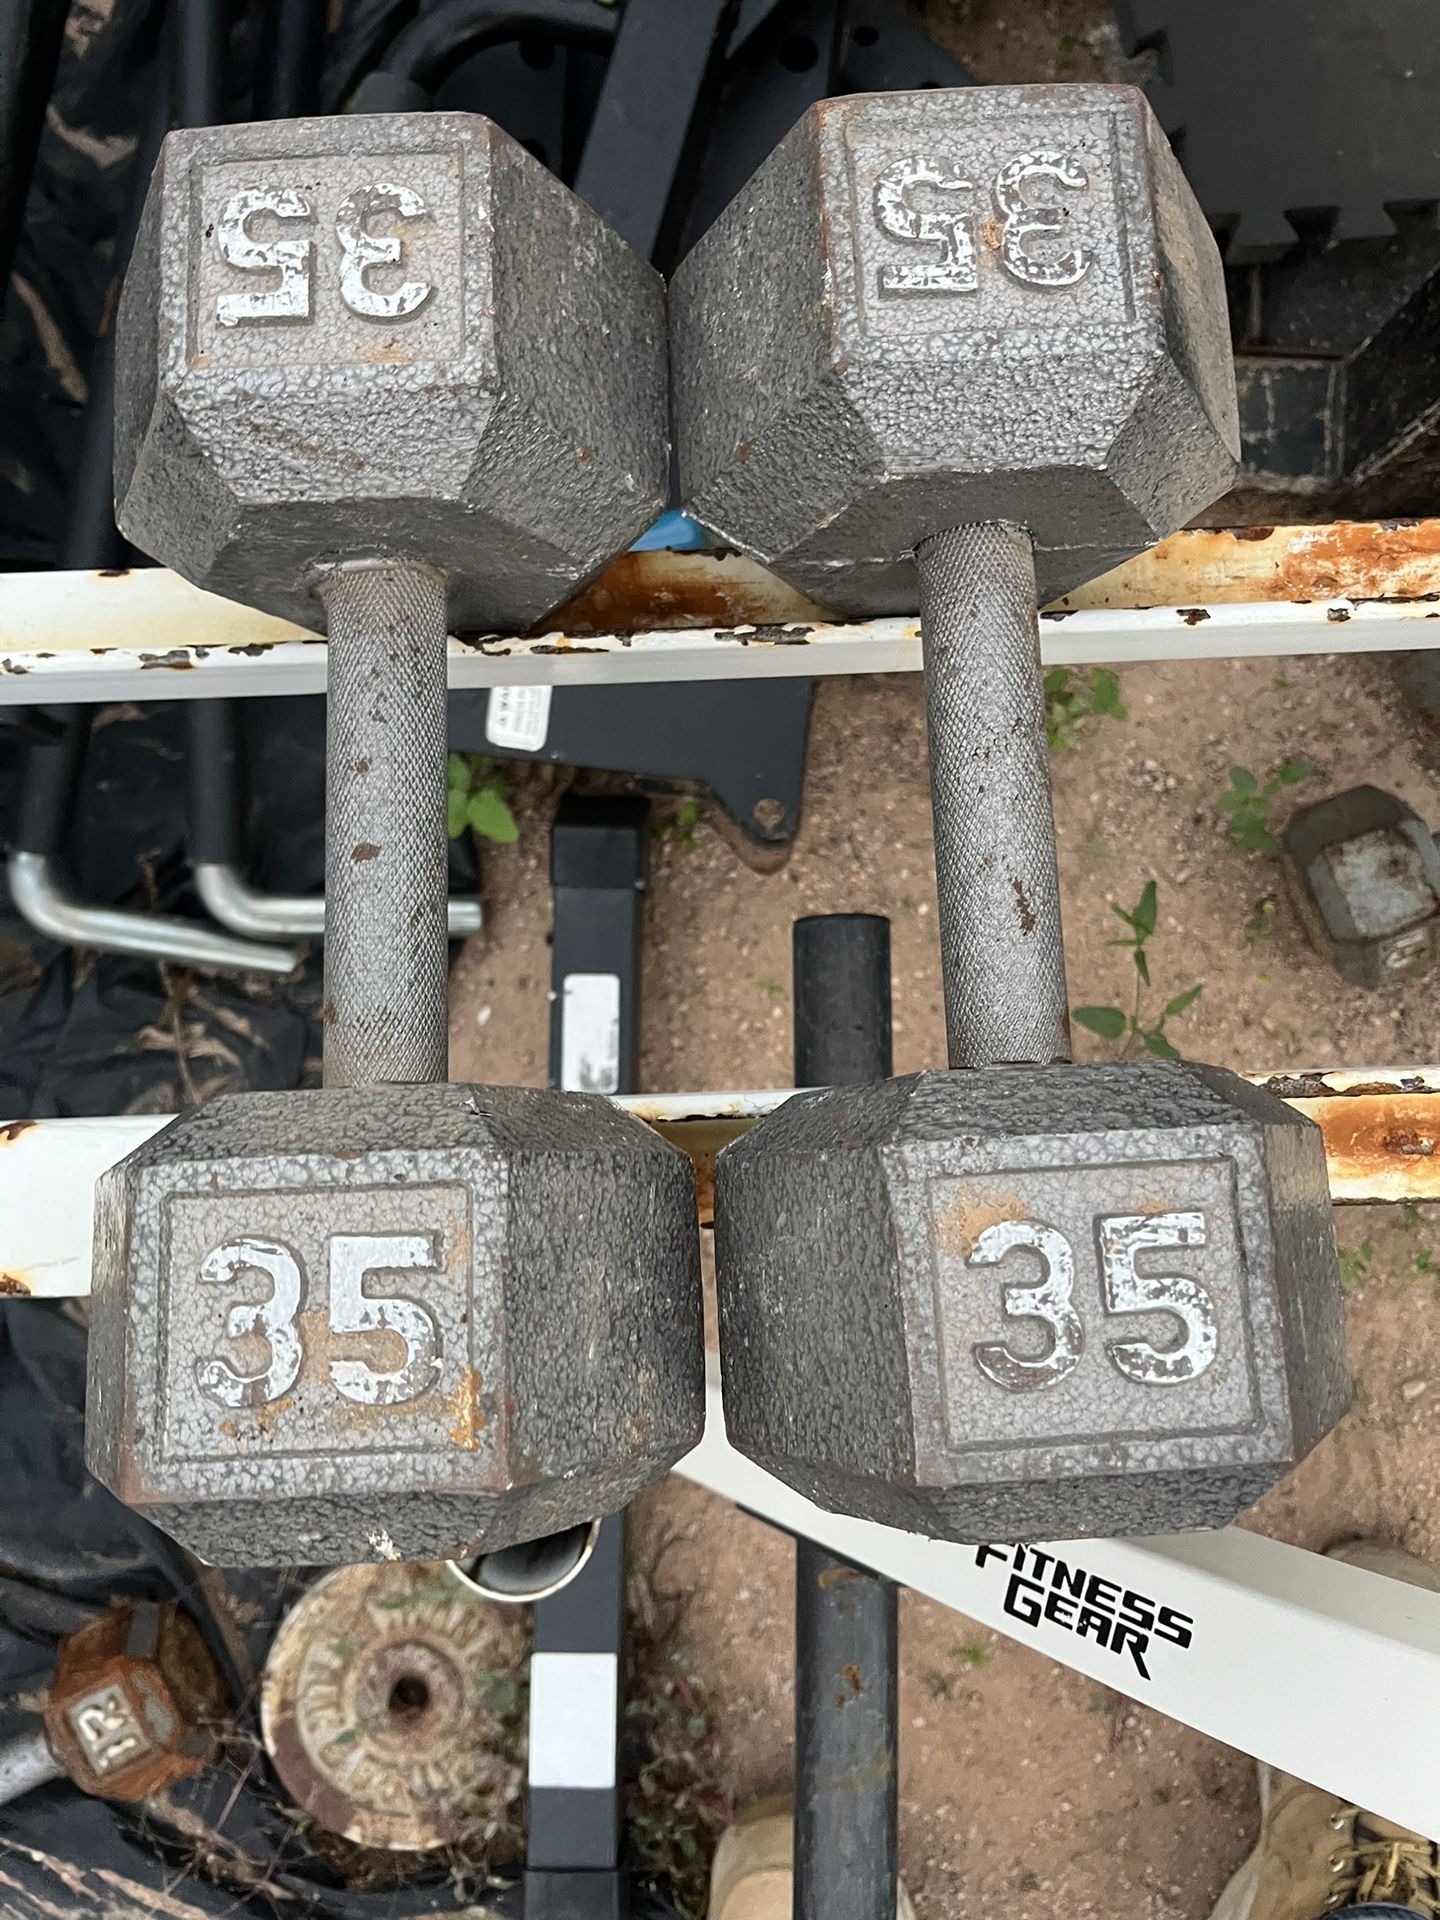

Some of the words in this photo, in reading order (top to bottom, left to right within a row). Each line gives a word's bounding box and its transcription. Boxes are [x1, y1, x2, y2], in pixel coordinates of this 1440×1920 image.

[216, 182, 432, 327] 35
[872, 150, 1092, 293] 35
[198, 1231, 444, 1408] 35
[966, 1211, 1217, 1392] 35
[1003, 1573, 1151, 1681] GEAR
